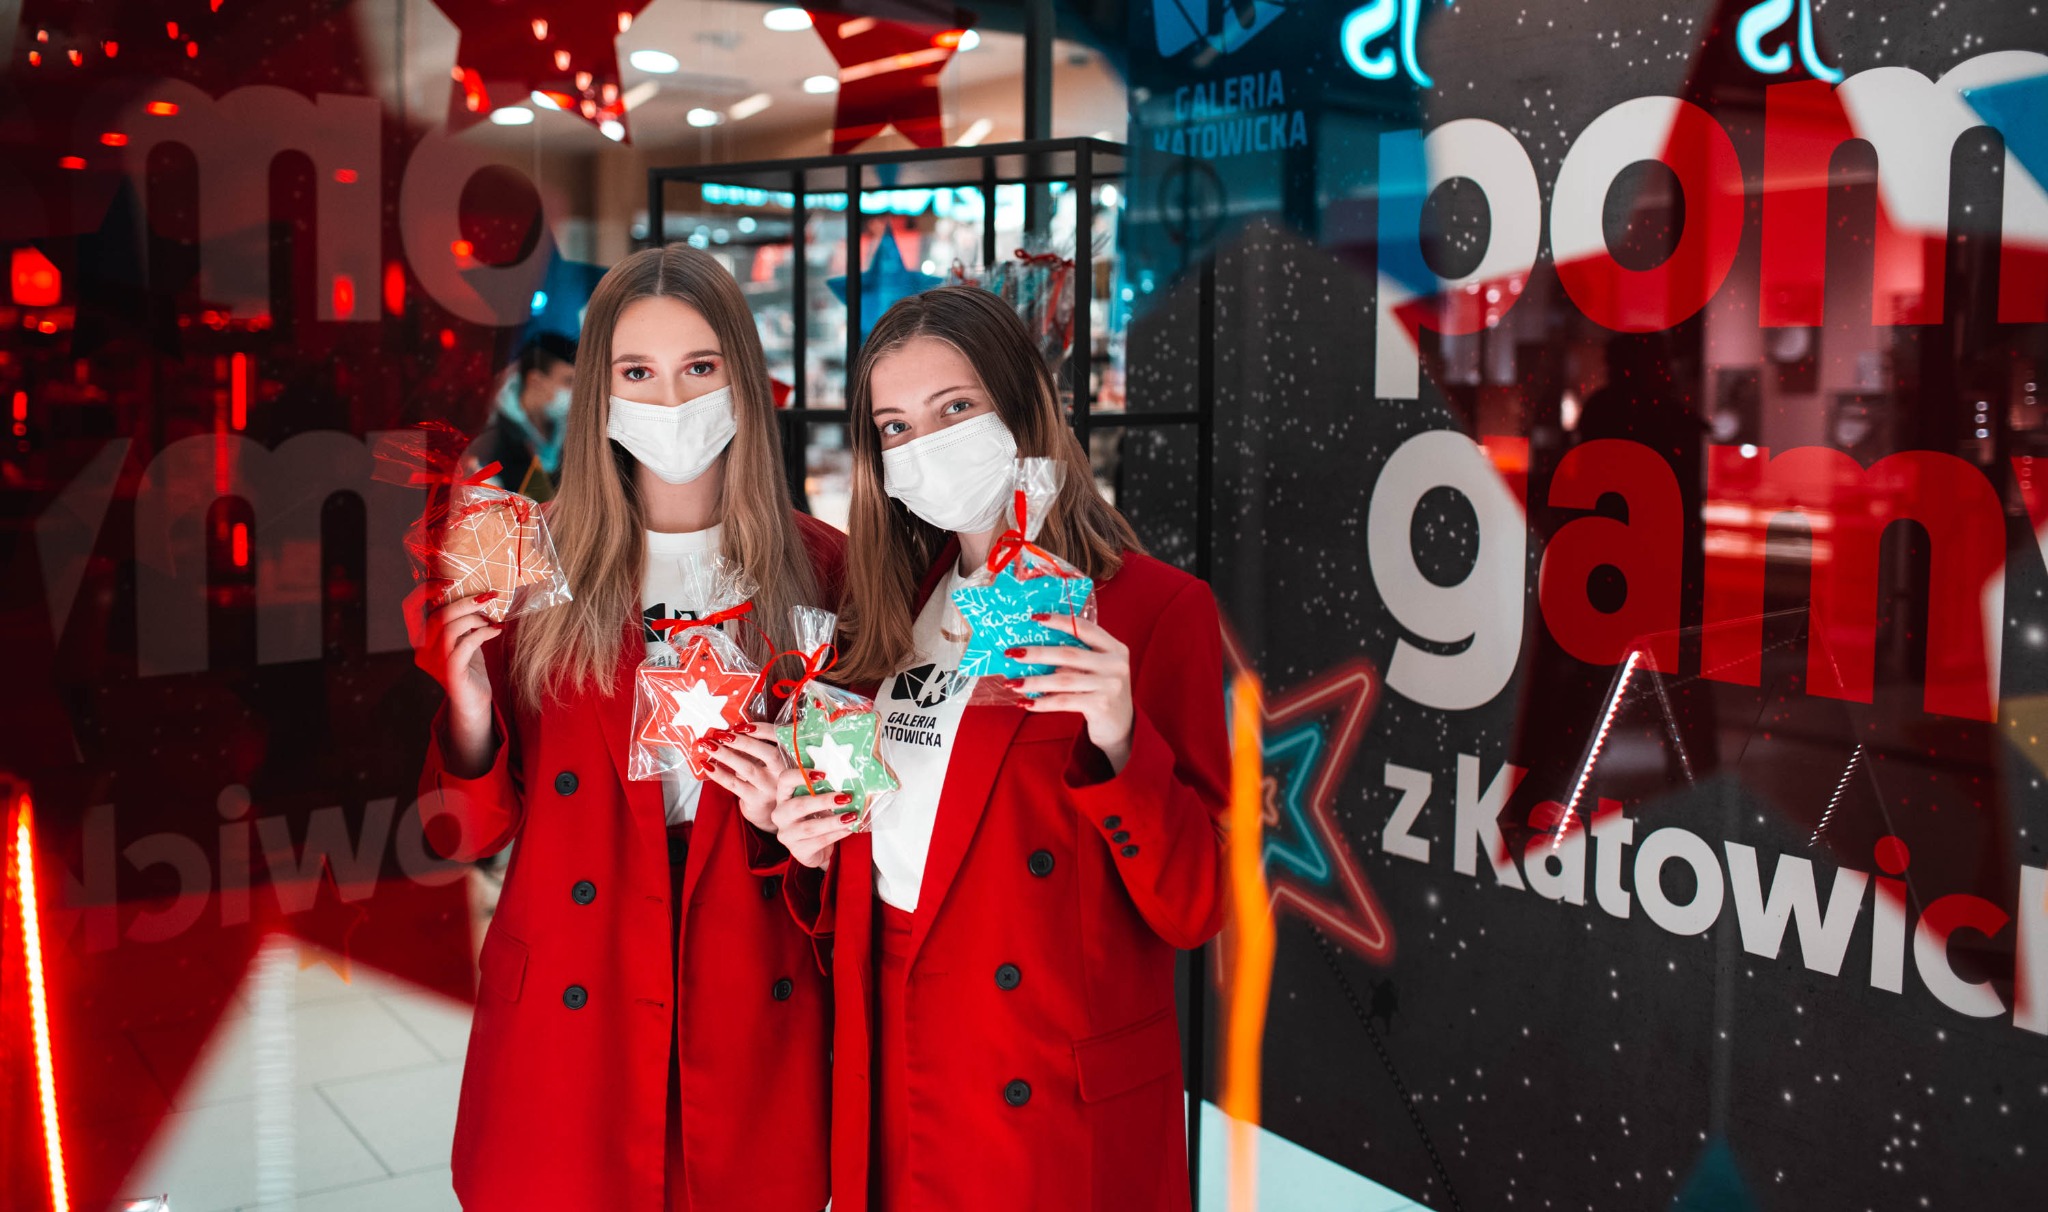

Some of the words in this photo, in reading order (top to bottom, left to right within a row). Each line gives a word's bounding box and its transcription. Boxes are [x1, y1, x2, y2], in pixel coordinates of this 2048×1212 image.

[1175, 69, 1284, 122] GALERIA
[1155, 110, 1308, 159] KATOWICKA
[1375, 50, 2048, 399] pom
[1367, 429, 2048, 724] gam
[981, 604, 1058, 628] Wesoł
[882, 725, 942, 747] ATOWICKA
[887, 712, 937, 729] GALERIA
[1382, 763, 1432, 864] z
